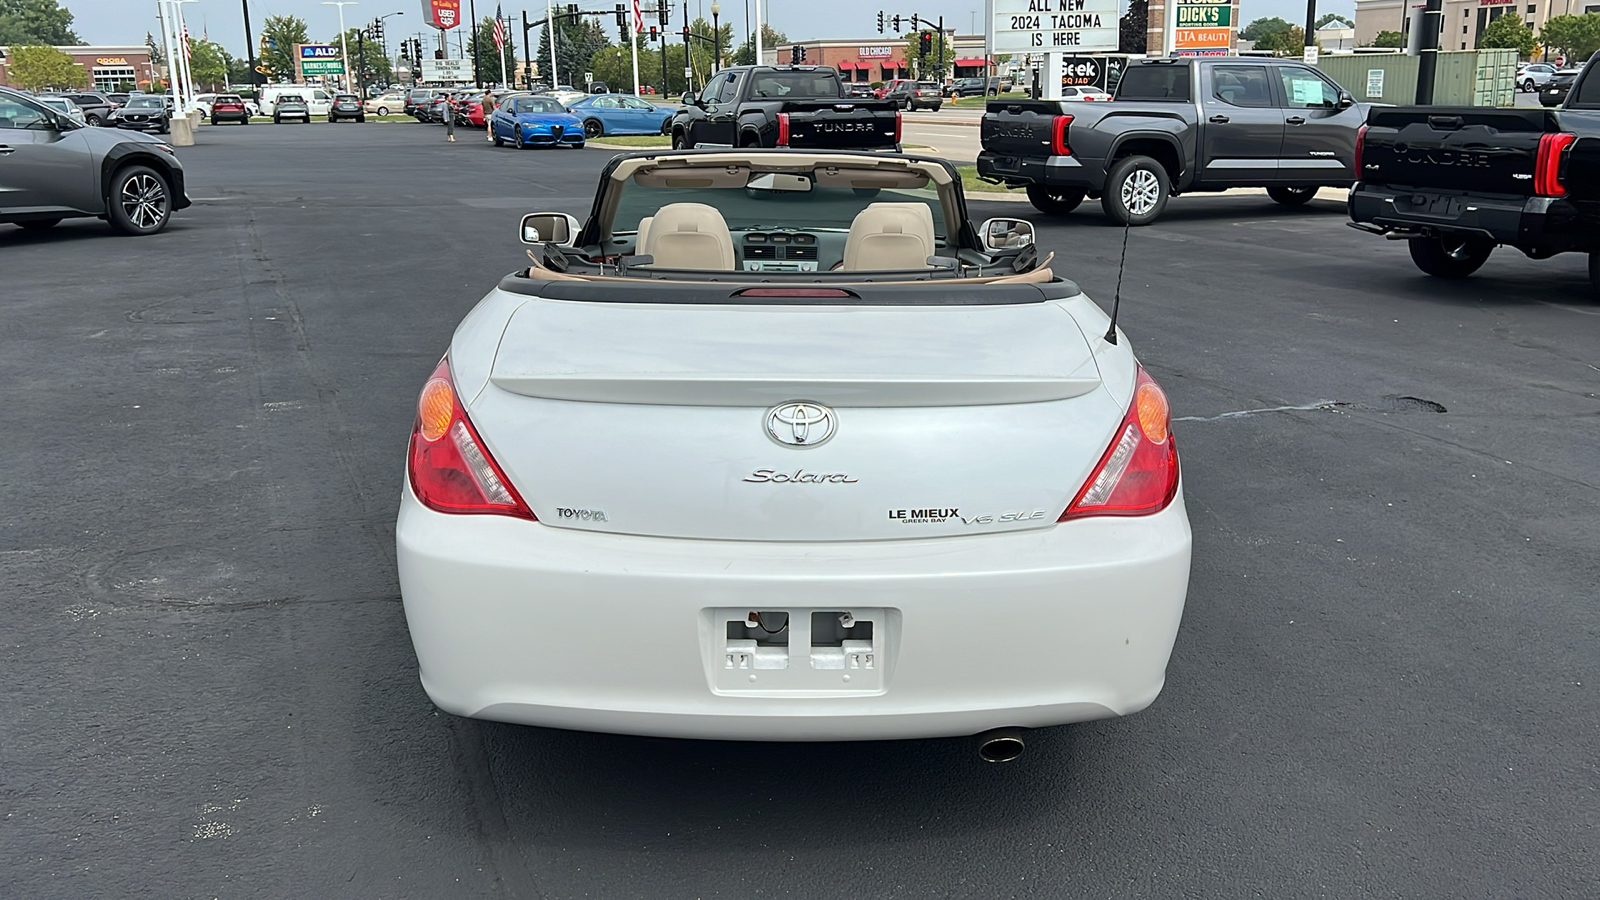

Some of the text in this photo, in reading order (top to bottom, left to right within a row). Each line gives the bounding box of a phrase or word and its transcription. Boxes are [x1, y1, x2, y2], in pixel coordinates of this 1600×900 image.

[1029, 0, 1084, 12] ALL NEW
[438, 9, 455, 17] USED
[1180, 7, 1219, 22] DICK'S
[441, 17, 454, 26] CARS
[1011, 14, 1101, 29] 2024 TACOMA
[1031, 32, 1080, 47] IS HERE
[1198, 33, 1228, 42] BEAUTY
[860, 46, 892, 56] OLD CHICAGO
[813, 123, 875, 132] TUNDRA
[741, 466, 859, 484] Solara
[556, 507, 608, 522] TOYOTA
[888, 508, 960, 520] LE MIEUX
[961, 509, 1046, 526] V6 SLE
